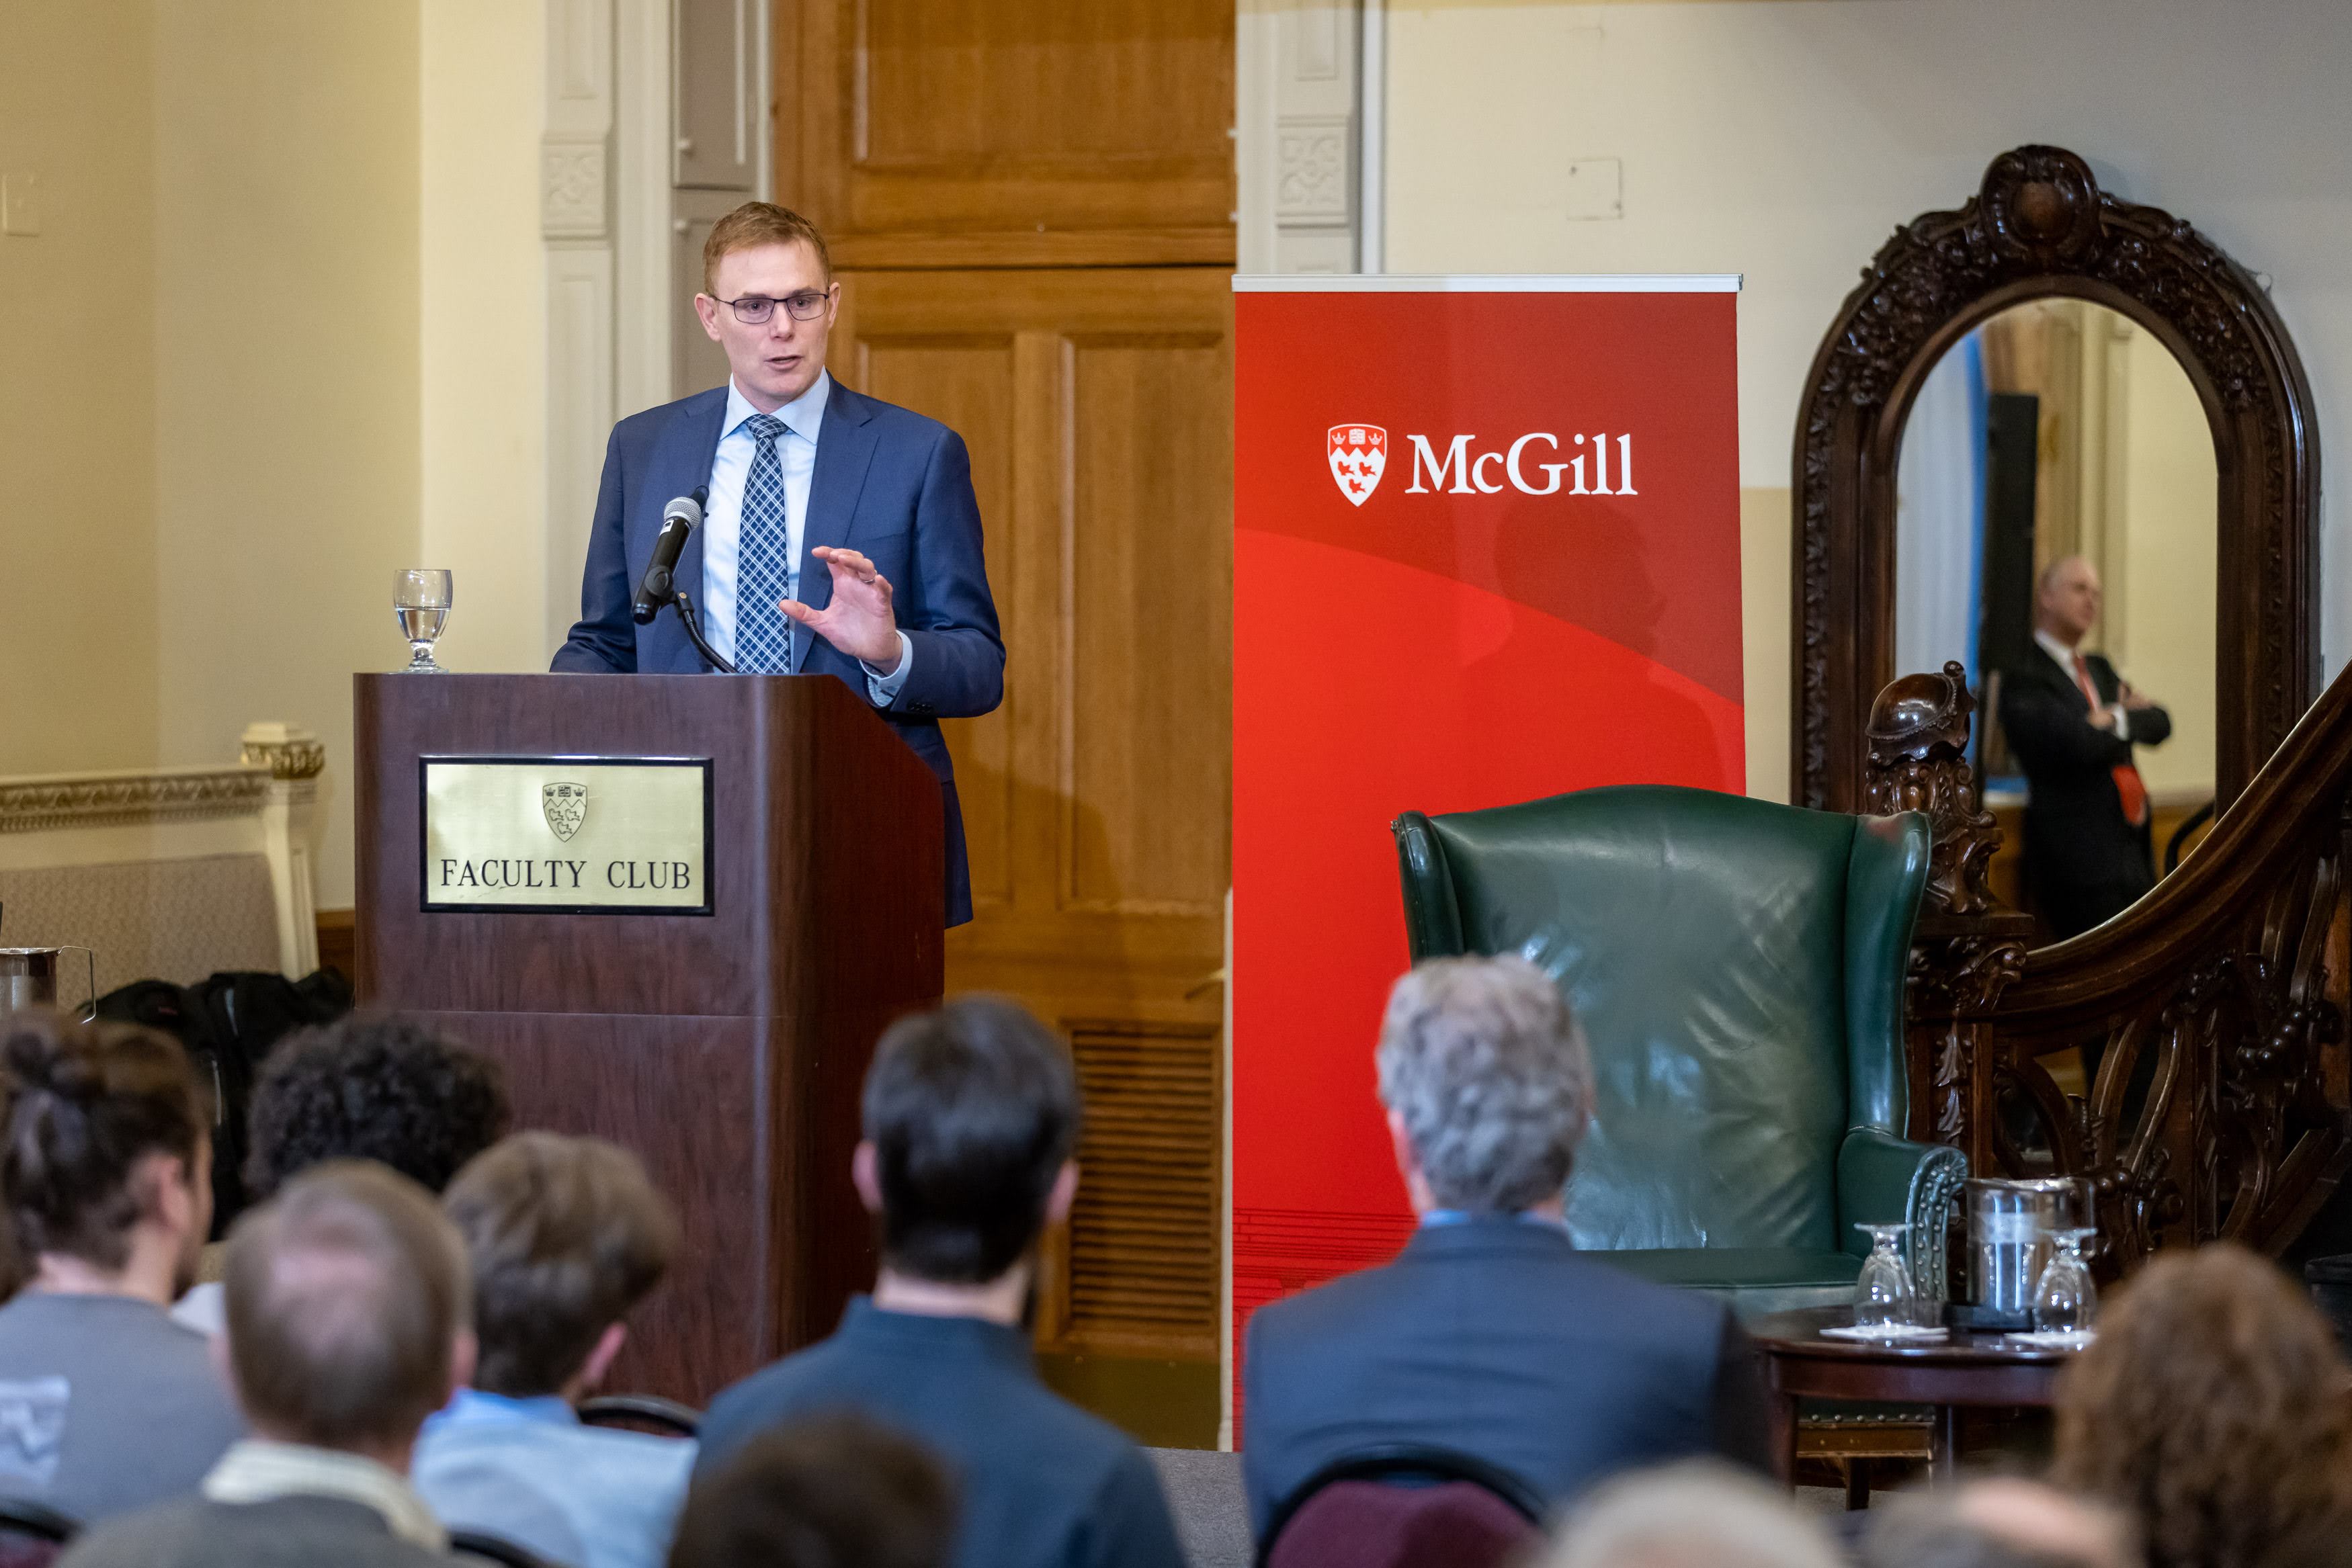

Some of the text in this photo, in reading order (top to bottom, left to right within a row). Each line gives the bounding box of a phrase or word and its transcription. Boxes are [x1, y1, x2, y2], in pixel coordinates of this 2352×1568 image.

[1404, 432, 1638, 496] McGill
[440, 859, 691, 889] FACULTY CLUB
